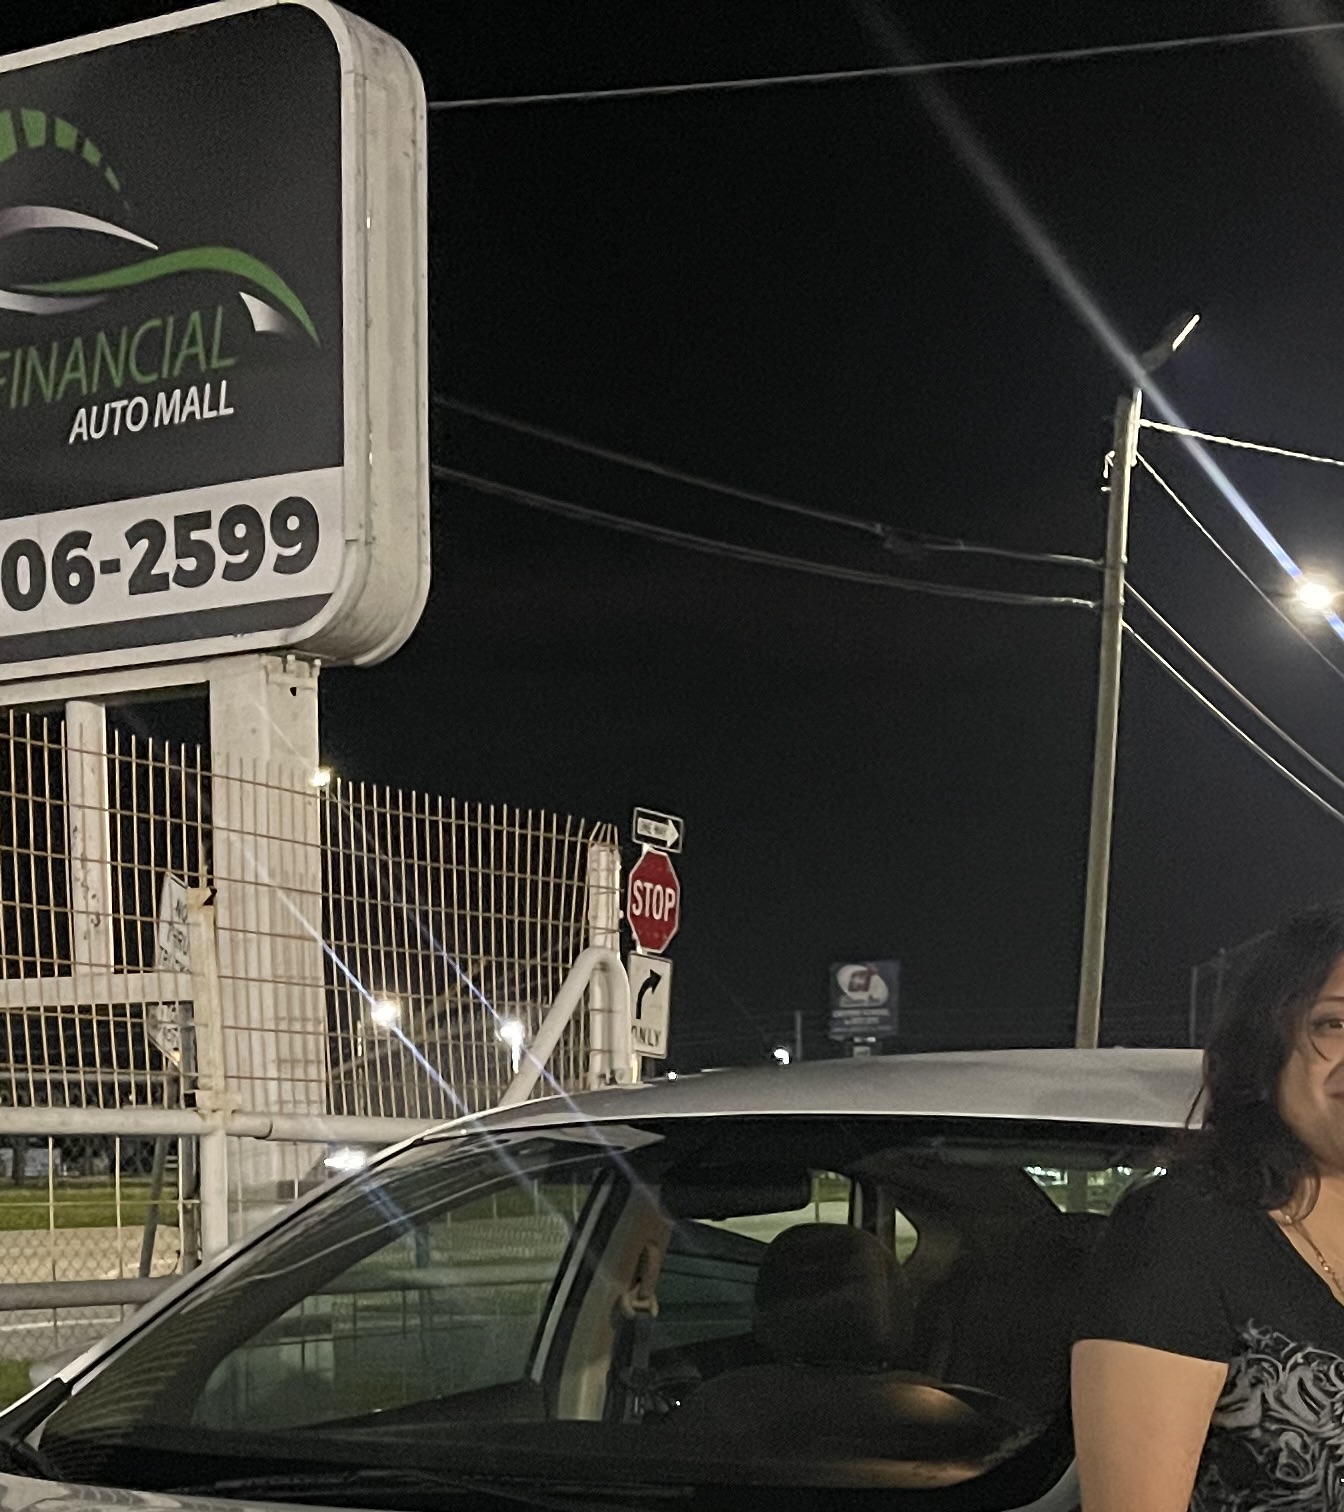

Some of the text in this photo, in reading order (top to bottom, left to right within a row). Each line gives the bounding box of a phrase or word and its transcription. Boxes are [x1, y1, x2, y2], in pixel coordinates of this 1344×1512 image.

[68, 380, 234, 444] AUTO MALL
[632, 879, 675, 921] STOP
